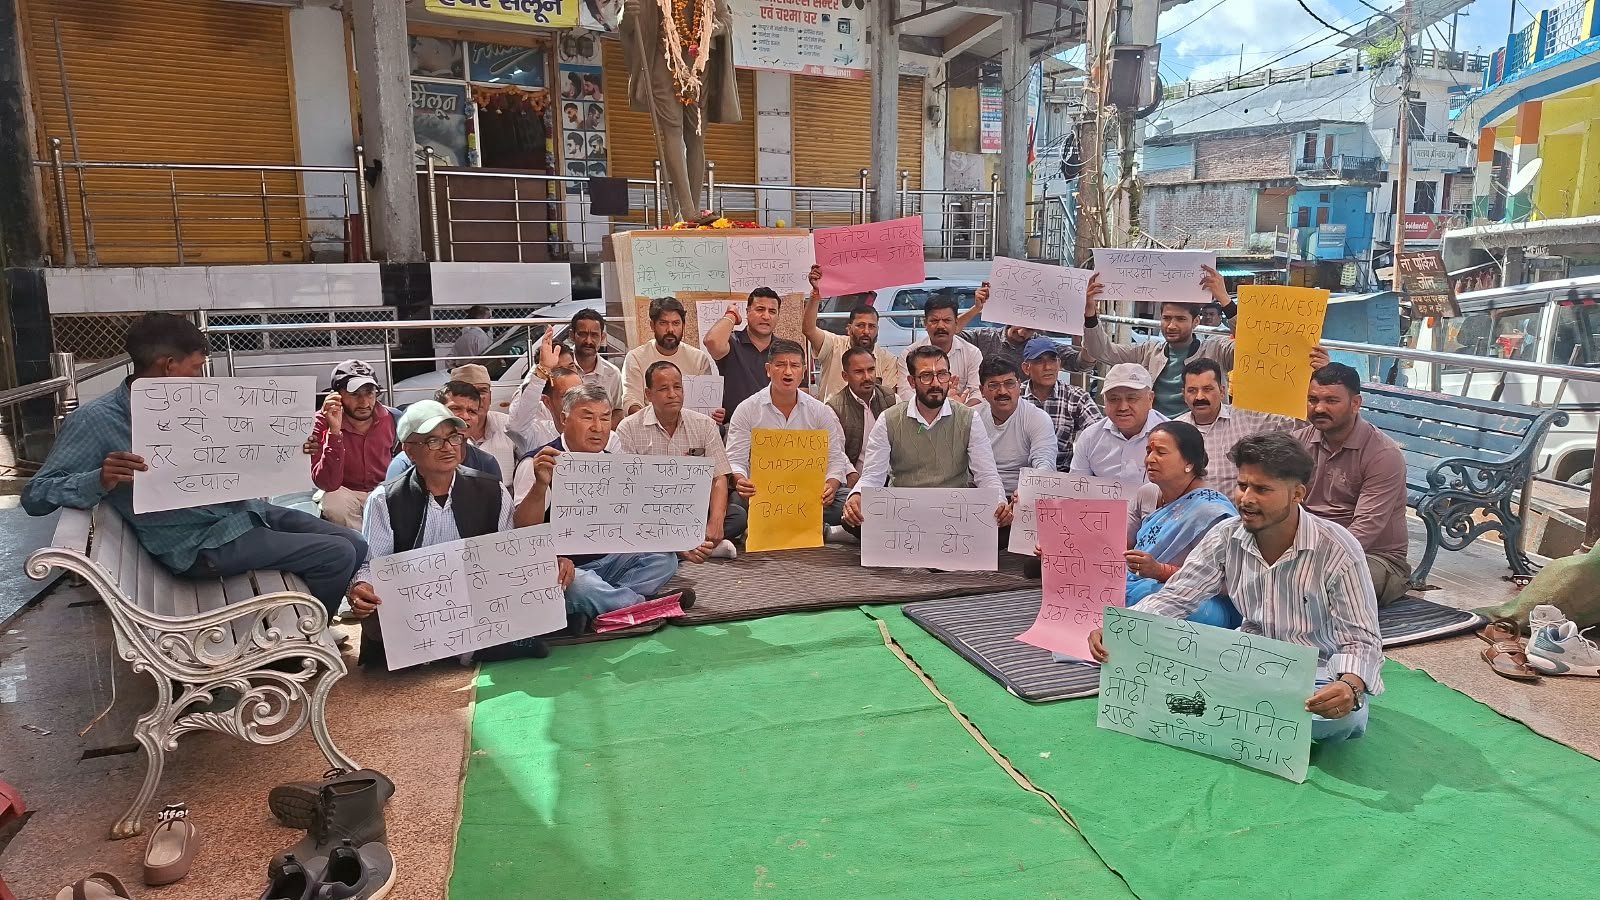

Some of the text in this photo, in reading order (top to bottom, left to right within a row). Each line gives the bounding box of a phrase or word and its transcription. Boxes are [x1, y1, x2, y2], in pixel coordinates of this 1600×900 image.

[500, 0, 562, 23] सलून
[775, 8, 802, 23] चश्मा
[803, 11, 818, 24] घर
[1400, 254, 1412, 271] नो
[1240, 291, 1325, 318] GYANESH
[1245, 316, 1320, 345] GADDAR
[1257, 337, 1291, 357] GO
[1238, 354, 1297, 387] BACK
[133, 383, 219, 410] चुनाव
[223, 416, 254, 433] एक
[754, 432, 829, 450] GYANESH
[235, 444, 265, 461] का
[623, 457, 645, 476] की
[758, 456, 826, 472] GADDAR
[564, 477, 615, 498] पारदर्शी
[645, 483, 696, 498] चुनाव
[768, 481, 797, 494] GO
[1070, 477, 1090, 493] की
[609, 502, 632, 515] का
[755, 501, 807, 518] BACK
[929, 491, 993, 528] चोर
[455, 539, 483, 563] की
[485, 594, 512, 614] का
[1107, 607, 1153, 647] देश
[1165, 618, 1200, 659] के
[1218, 635, 1297, 679] तीन
[1231, 738, 1294, 775] कुमार
